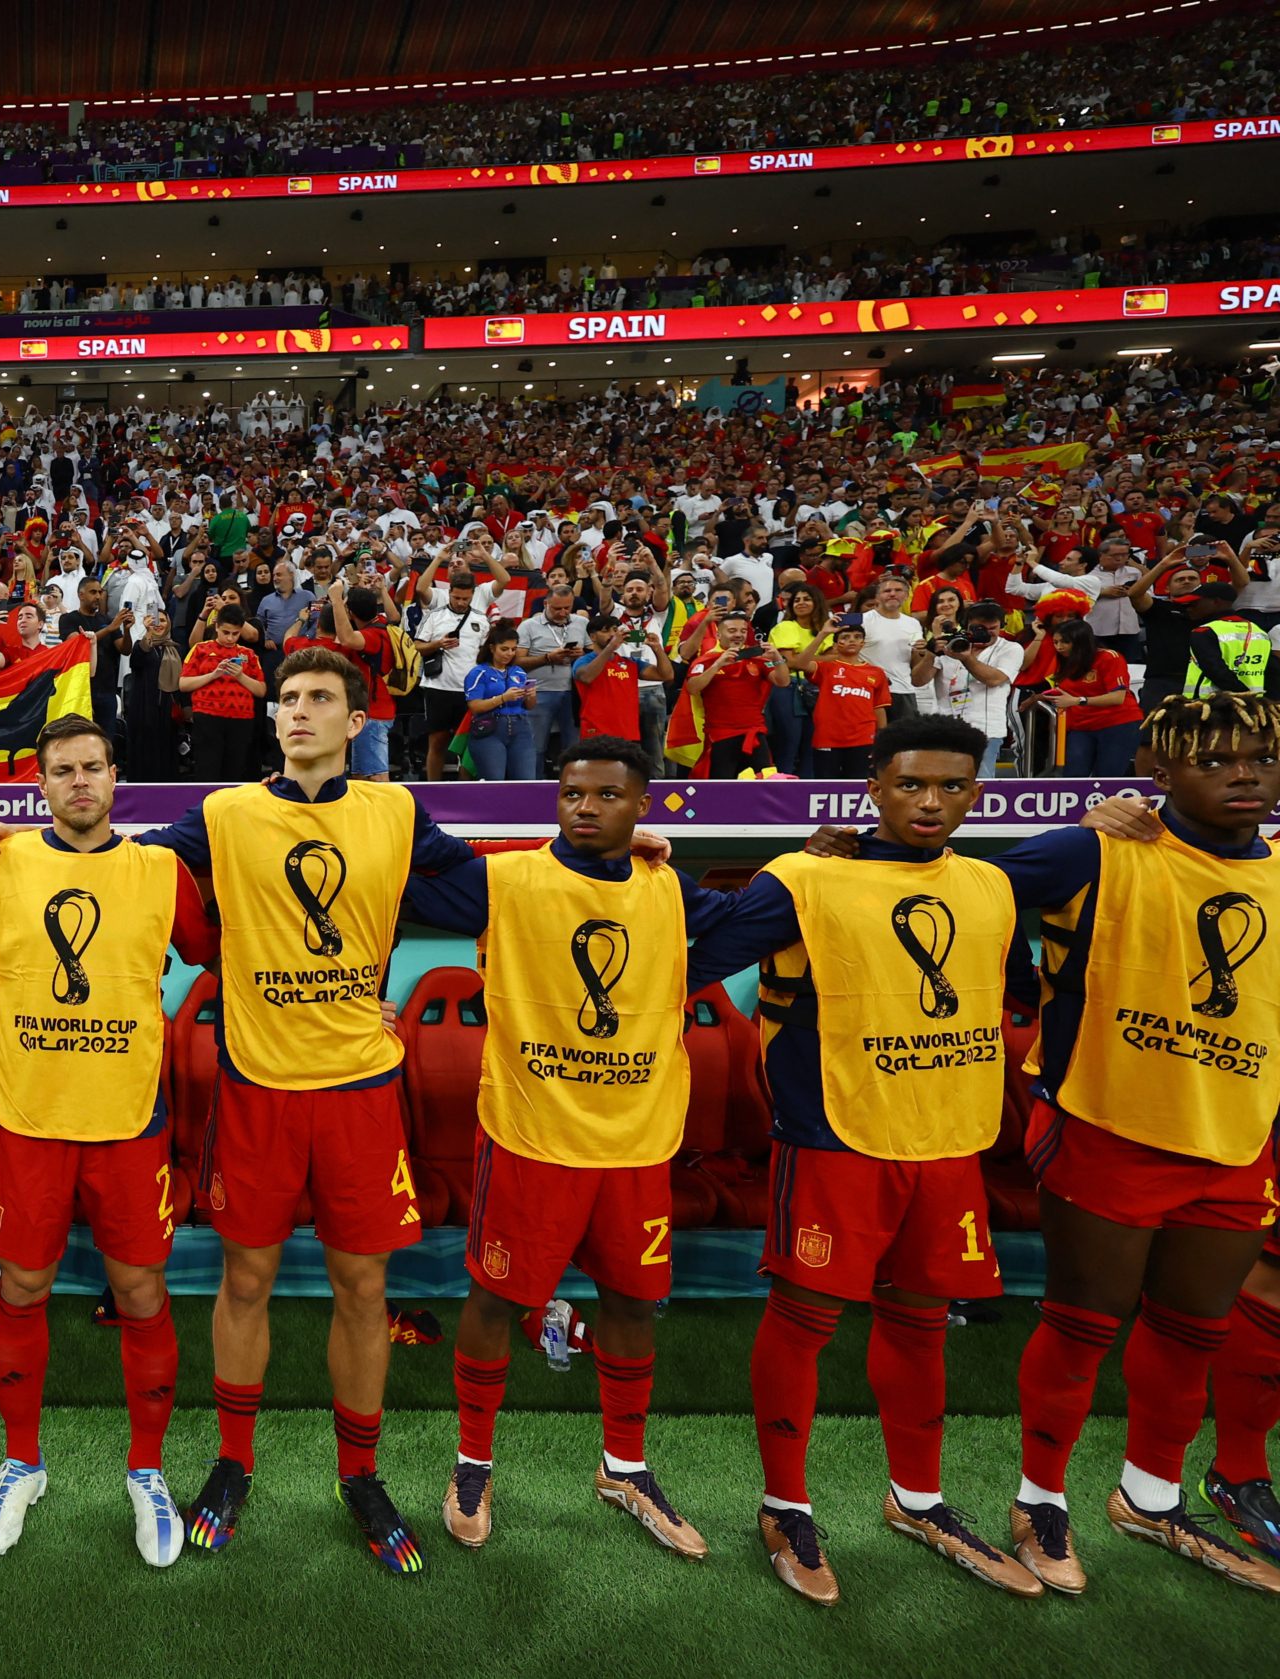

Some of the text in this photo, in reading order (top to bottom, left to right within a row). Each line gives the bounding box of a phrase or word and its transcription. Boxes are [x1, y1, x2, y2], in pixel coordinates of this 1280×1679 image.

[1214, 120, 1280, 138] SPAIN
[750, 153, 812, 169] SPAIN
[339, 175, 397, 190] SPAIN
[24, 316, 80, 328] now is all
[569, 315, 665, 339] SPAIN
[79, 339, 145, 355] SPAIN
[832, 685, 871, 699] Spain
[809, 794, 876, 818] FIFA
[1014, 793, 1079, 818] CUP
[255, 972, 293, 985] FIFA
[295, 968, 360, 985] WORLD
[15, 1015, 137, 1034] FIFA WORLD CUP
[1115, 1008, 1268, 1058] FIFA WRLD CUP
[20, 1034, 129, 1054] Qatar2022
[863, 1036, 907, 1051] FIFA
[908, 1031, 970, 1050] WORLD
[521, 1041, 656, 1067] FIFA WORLD CU
[875, 1047, 997, 1076] Qatar2022
[528, 1059, 650, 1085] Qatar2022
[391, 1150, 416, 1199] 4
[156, 1163, 174, 1221] 2
[641, 1216, 668, 1265] 2
